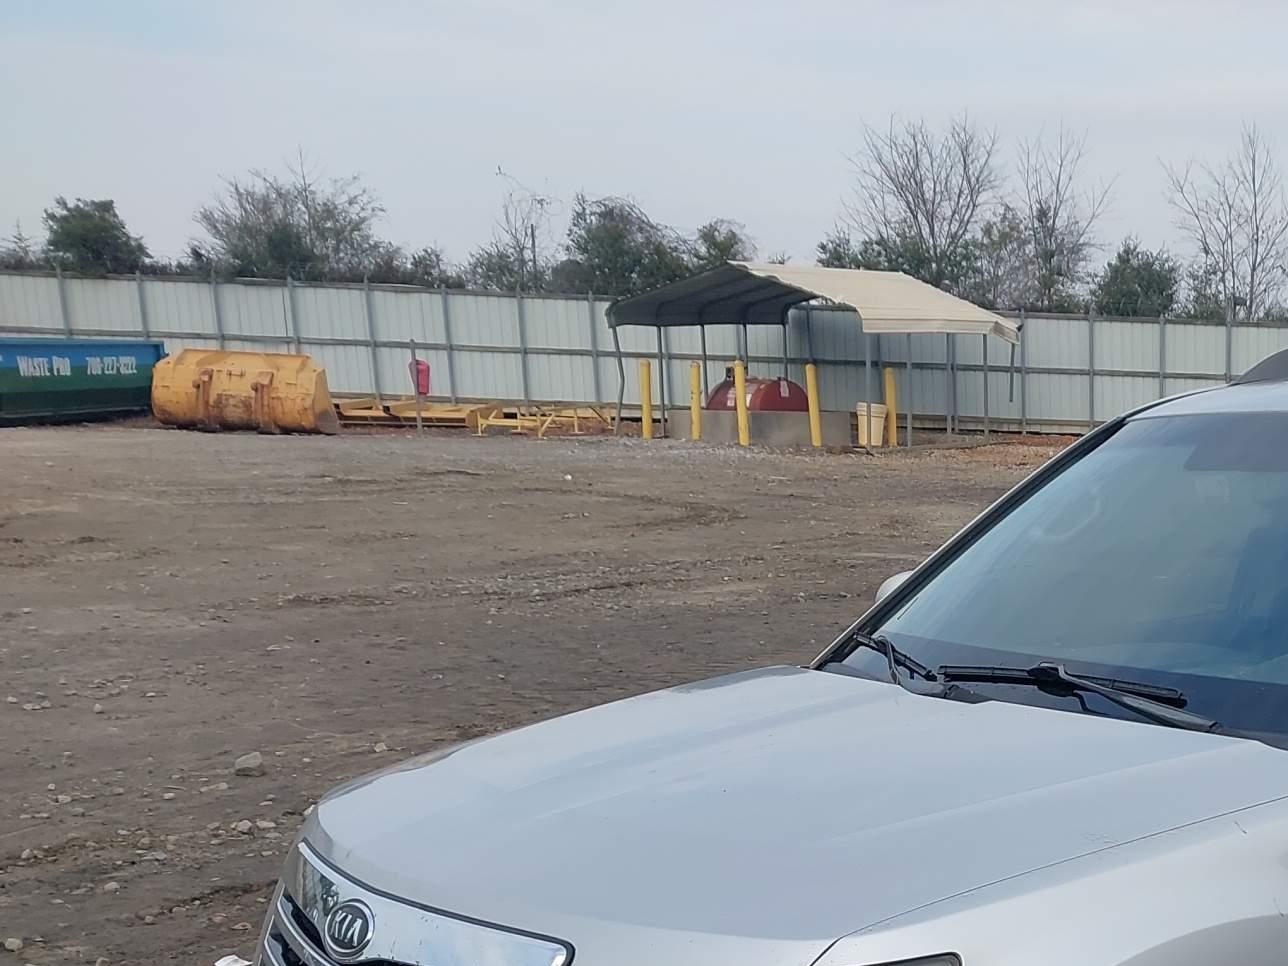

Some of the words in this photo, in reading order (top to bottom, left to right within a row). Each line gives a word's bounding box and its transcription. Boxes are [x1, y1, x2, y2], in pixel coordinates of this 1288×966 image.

[16, 356, 50, 376] WASTE
[52, 356, 72, 376] PRO
[329, 909, 362, 946] KIA
